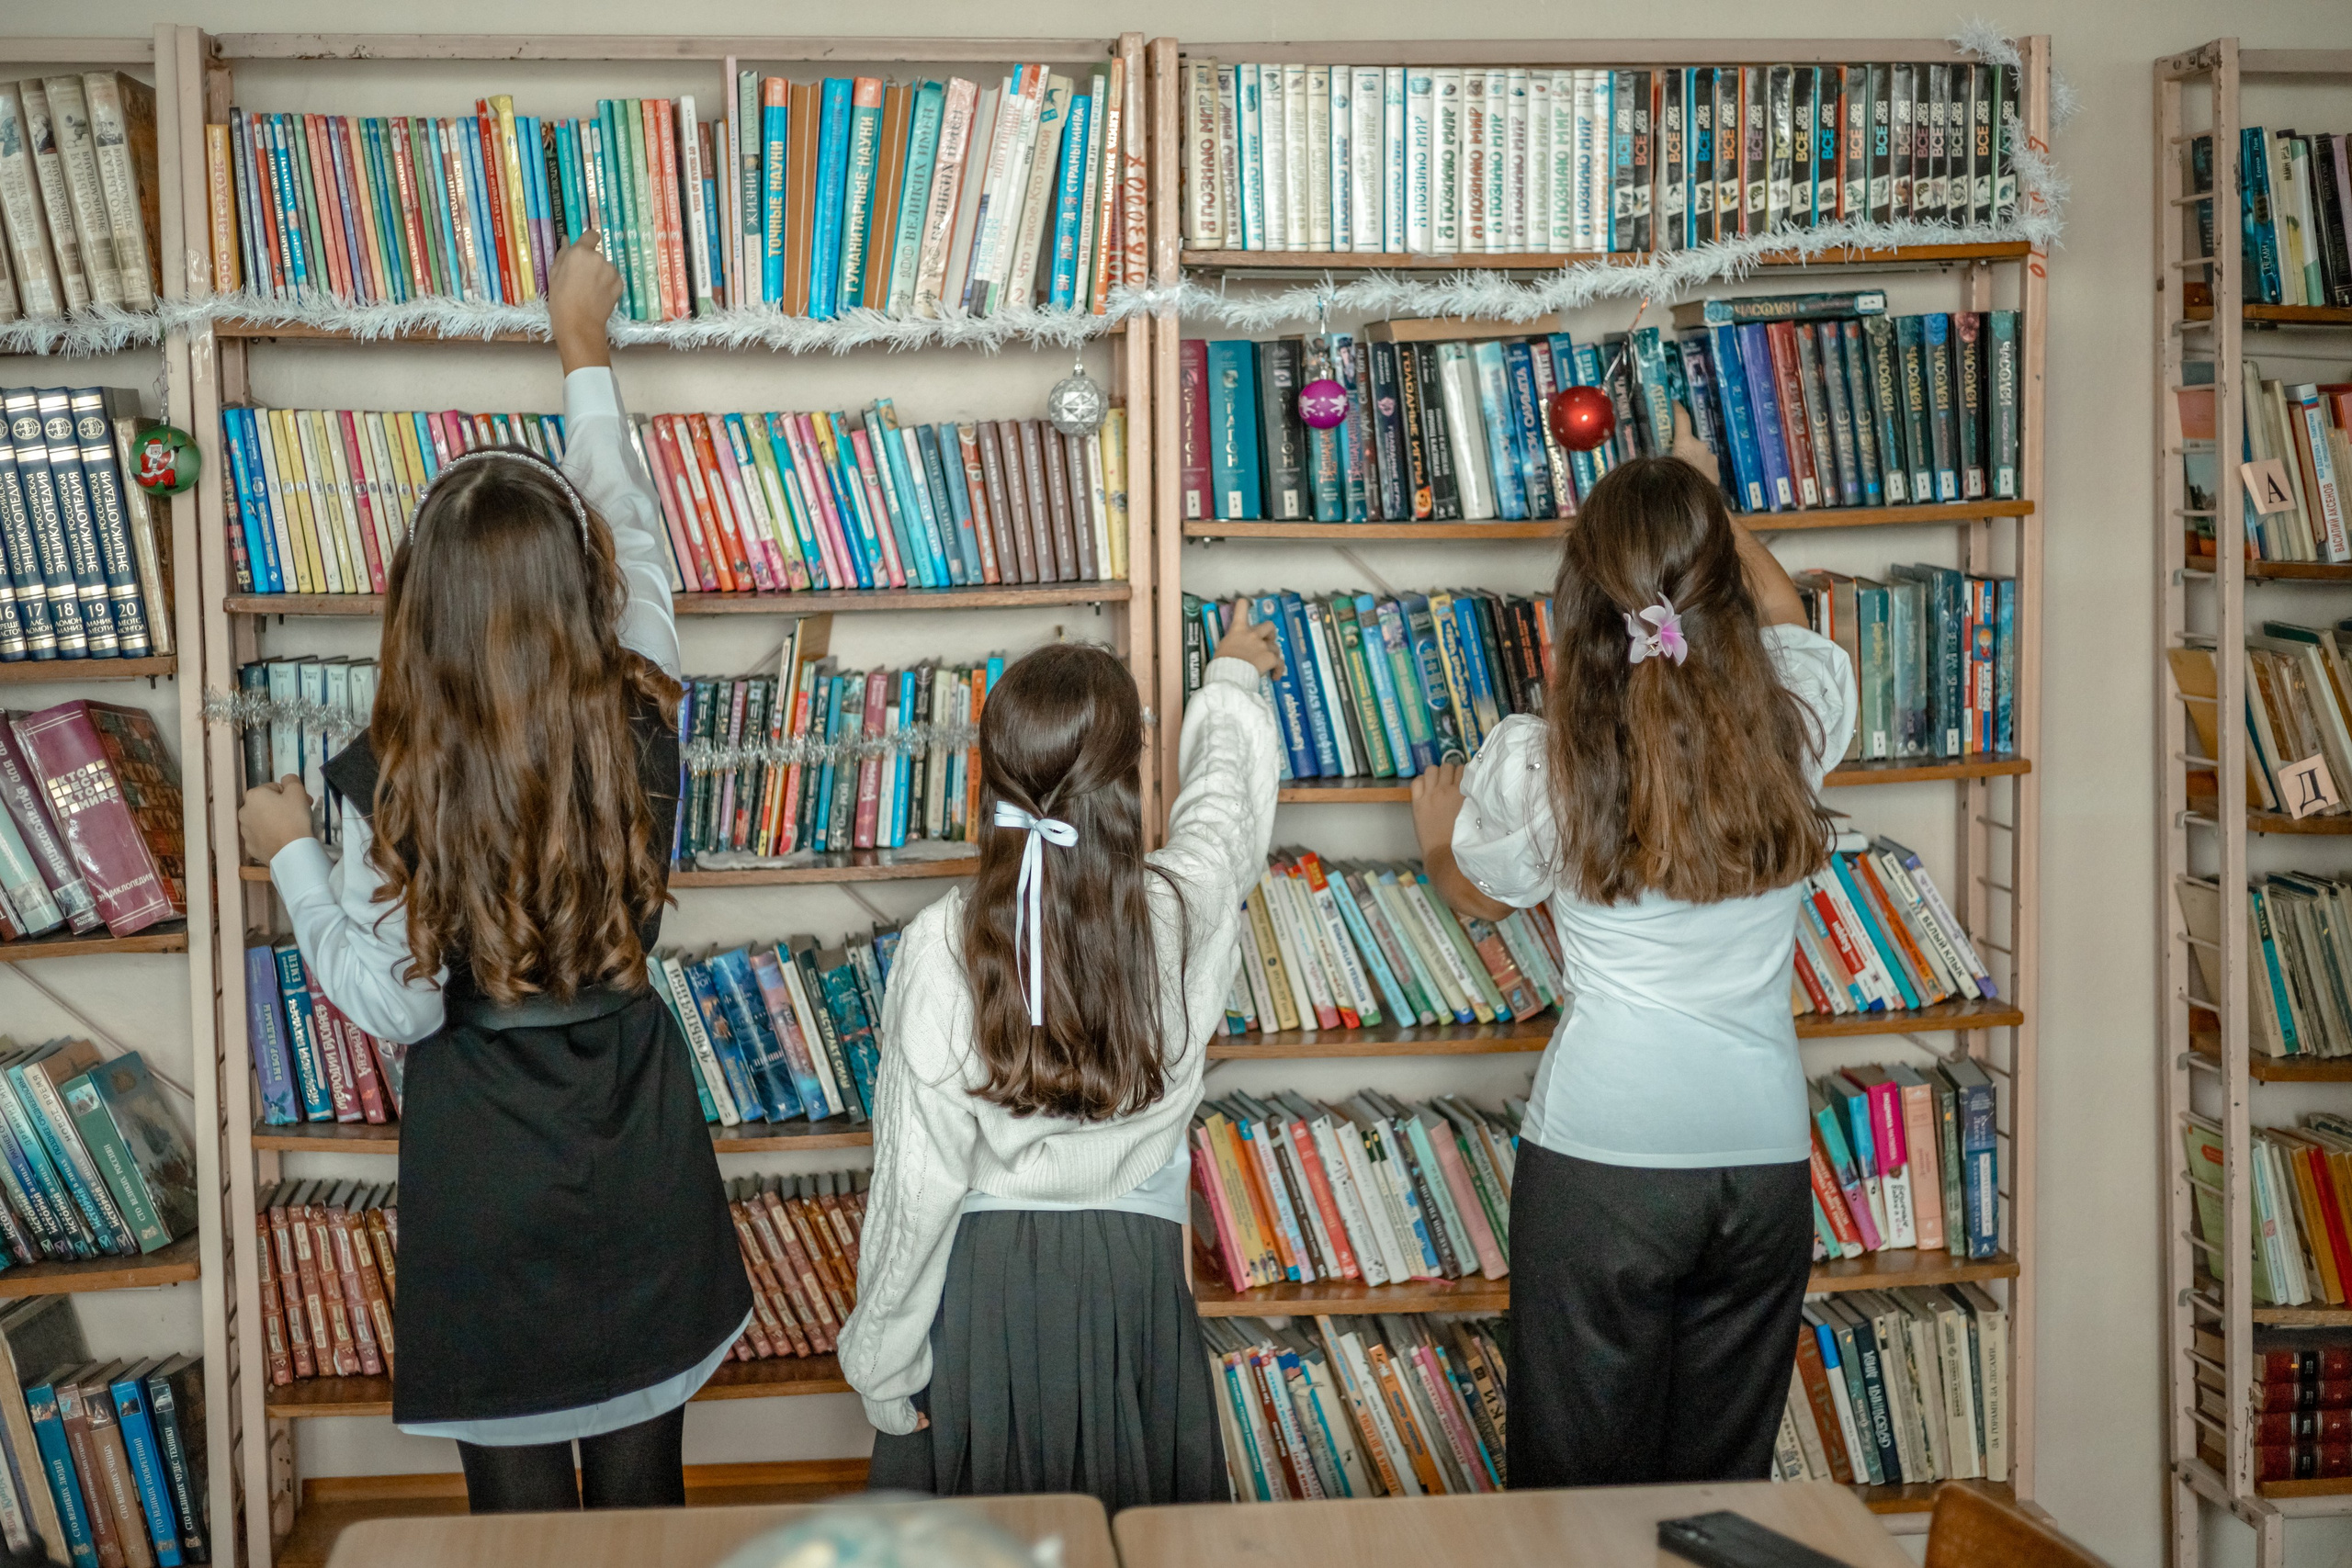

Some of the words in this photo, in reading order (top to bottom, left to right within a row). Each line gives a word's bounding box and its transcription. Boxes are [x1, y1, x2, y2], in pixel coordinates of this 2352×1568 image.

[1071, 105, 1087, 142] МИРА
[1199, 94, 1214, 133] МИР
[1414, 115, 1427, 147] МИР
[1442, 105, 1455, 144] МИР
[1470, 106, 1483, 144] МИР
[1489, 112, 1502, 148] МИР
[1554, 106, 1568, 145] МИР
[686, 145, 695, 154] ОТ
[1577, 115, 1589, 151] МИР
[1617, 134, 1630, 165] ВСЕ
[1634, 135, 1647, 165] ВСЕ
[1667, 131, 1679, 163] ВСЕ
[1697, 130, 1710, 161] ВСЕ
[1722, 129, 1735, 160] ВСЕ
[1795, 130, 1808, 162] ВСЕ
[1821, 129, 1834, 159] ВСЕ
[1849, 129, 1862, 159] ВСЕ
[687, 156, 698, 180] ЗЕМЛИ
[1023, 145, 1034, 165] Вода
[1066, 142, 1082, 192] СТРАНЫ
[2254, 156, 2262, 178] Елена
[81, 149, 107, 232] ЭНЦИКЛОПЕДИЯ
[100, 148, 124, 231] ШКОЛЬНАЯ
[113, 147, 134, 231] ЭНЦИКЛОПЕДИЯ
[690, 181, 700, 192] ДО
[903, 159, 928, 242] ВЕЛИКИХ
[916, 106, 935, 157] ИМЕН
[931, 161, 956, 242] ВЕЛИКИХ
[944, 107, 965, 159] ИМЕН
[1200, 138, 1216, 217] ПОЗНАЮ
[1413, 151, 1427, 212] ПОЗНАЮ
[1440, 148, 1455, 221] ПОЗНАЮ
[1469, 149, 1484, 221] ПОЗНАЮ
[1488, 151, 1502, 217] ПОЗНАЮ
[1553, 150, 1569, 221] ПОЗНАЮ
[1577, 152, 1589, 220] ПОЗНАЮ
[40, 161, 64, 234] ШКОЛЬНАЯ
[51, 159, 73, 233] ЭНЦИКЛОПЕДИЯ
[70, 151, 96, 233] ШКОЛЬНАЯ
[692, 192, 702, 212] НЕБА
[1017, 250, 1033, 279] Что
[1035, 128, 1053, 172] такой
[844, 170, 868, 293] ГУМАНИТАРНЫЕ
[1201, 220, 1216, 232] Я
[1413, 216, 1426, 227] Я
[1437, 224, 1454, 240] Я
[1467, 224, 1483, 239] Я
[1487, 220, 1501, 233] Я
[1553, 224, 1569, 238] Я
[1575, 223, 1589, 236] Я
[1906, 346, 1922, 412] ЧАСОДЕИ
[1933, 344, 1949, 411] ЧАСОДЕИ
[1962, 344, 1977, 409] ЧАСОДЕИ
[1400, 351, 1420, 436] ГОЛОДНЫЕ
[1412, 439, 1427, 484] ИГРЫ
[26, 471, 45, 531] РОССИЙСКАЯ
[56, 472, 76, 531] РОССИЙСКАЯ
[88, 471, 107, 531] РОССИЙСКАЯ
[2267, 472, 2288, 503] А
[2323, 481, 2337, 516] АКСЕНОВ
[3, 470, 37, 573] ЭНЦИКЛОПЕДИЯ
[35, 469, 69, 573] ЭНЦИКЛОПЕДИЯ
[66, 470, 99, 573] ЭНЦИКЛОПЕДИЯ
[96, 469, 131, 572] ЭНЦИКЛОПЕДИЯ
[2328, 515, 2345, 553] ВАСИЛИЙ
[6, 533, 23, 575] БОЛЬШАЯ
[39, 532, 54, 575] БОЛЬШАЯ
[70, 533, 85, 574] БОЛЬШАЯ
[100, 532, 117, 574] БОЛЬШАЯ
[26, 603, 42, 617] 17
[55, 603, 74, 617] 18
[87, 603, 105, 617] 19
[118, 603, 136, 617] 20
[1299, 660, 1322, 710] БУСЛАЕВ
[1360, 696, 1379, 730] КНИГА
[57, 768, 87, 785] КТО
[72, 771, 110, 790] ЕСТЬ
[2295, 766, 2329, 814] Д
[59, 807, 70, 818] В
[79, 788, 119, 809] МИРЕ
[65, 787, 95, 805] КТО
[97, 874, 154, 903] ЭНЦИКЛОПЕДИЯ
[1829, 918, 1854, 953] Барри
[1920, 913, 1948, 951] БЕЛЫЙ
[1942, 947, 1965, 978] КЛЫК
[288, 953, 301, 983] ЕМЕЦ
[261, 1002, 277, 1046] ВЕДЬМЫ
[268, 1045, 283, 1081] ВЫБОР
[817, 1006, 842, 1057] ЭКСТРАКТ
[833, 1057, 852, 1090] СИЛЫ
[30, 1072, 54, 1107] ВРЕМЯ
[3, 1100, 34, 1147] ДРЕВНИЙ
[41, 1124, 62, 1156] ПОЗДНЕЕ
[49, 1107, 74, 1142] НОВОЕ
[102, 1142, 123, 1176] РОССИЯН
[75, 1185, 103, 1229] ИСТОРИЯ
[93, 1184, 121, 1228] ИСТОРИЯ
[118, 1174, 139, 1206] ВЕЛИКИХ
[31, 1190, 60, 1233] ИСТОРИЯ
[51, 1190, 79, 1234] ИСТОРИЯ
[133, 1205, 147, 1222] СТО
[102, 1443, 118, 1472] УЧЕНЫХ
[164, 1425, 178, 1459] ТЕХНИКИ
[1991, 1437, 1998, 1448] ЗА
[51, 1457, 68, 1487] ЛЮДЕЙ
[133, 1436, 153, 1486] ИЗОБРЕТЕНИЙ
[171, 1459, 183, 1483] ЧУДЕС
[60, 1485, 77, 1521] ВЕЛИКИХ
[109, 1471, 126, 1505] ВЕЛИКИХ
[146, 1484, 162, 1517] ВЕЛИКИХ
[175, 1482, 190, 1515] ВЕЛИКИХ
[118, 1504, 130, 1519] СТО
[153, 1517, 165, 1534] СТО
[183, 1515, 193, 1530] СТО
[69, 1520, 81, 1539] СТО
